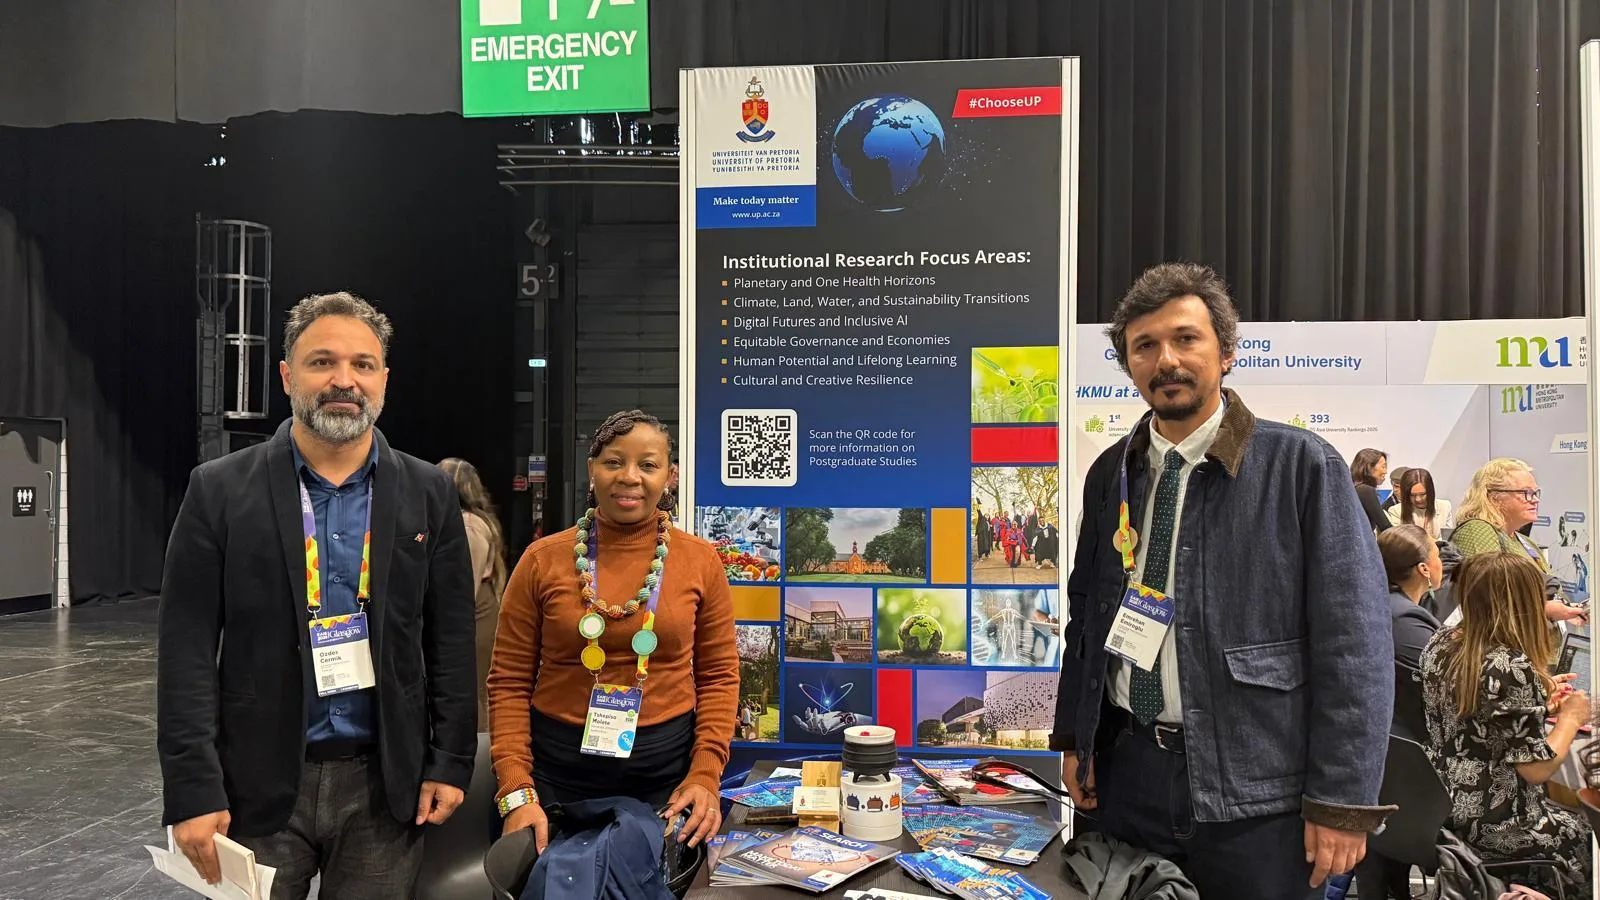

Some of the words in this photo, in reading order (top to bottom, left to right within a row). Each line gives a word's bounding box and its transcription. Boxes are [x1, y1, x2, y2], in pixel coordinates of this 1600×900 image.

[471, 30, 638, 62] EMERGENCY
[527, 64, 584, 92] EXIT
[968, 95, 1042, 109] #ChooseUP
[712, 150, 754, 158] UNIVERSITEIT
[712, 157, 753, 166] UNIVERSITY
[755, 157, 763, 165] OF
[713, 196, 739, 206] Make
[740, 195, 766, 207] today
[767, 196, 800, 204] matter
[731, 211, 780, 219] www.up.ac.za
[722, 253, 830, 270] Institutional
[835, 251, 915, 268] Research
[920, 250, 970, 267] Focus
[974, 249, 1032, 265] Areas:
[733, 276, 788, 292] Planetary
[790, 276, 812, 289] and
[815, 276, 840, 288] One
[842, 275, 881, 287] Health
[884, 274, 936, 286] Horizons
[733, 296, 780, 309] Climate,
[782, 295, 814, 309] Land,
[817, 295, 855, 308] Water,
[858, 294, 880, 307] and
[883, 293, 961, 308] Sustainability
[963, 291, 1030, 305] Transitions
[733, 315, 769, 331] Digital
[772, 315, 815, 328] Futures
[818, 315, 841, 328] and
[843, 314, 894, 327] Inclusive
[896, 314, 909, 326] AI
[733, 335, 787, 350] Equitable
[789, 335, 859, 348] Governance
[861, 334, 884, 347] and
[887, 333, 951, 346] Economies
[733, 354, 775, 367] Human
[778, 354, 829, 367] Potential
[831, 354, 854, 367] and
[857, 353, 903, 369] Lifelong
[906, 353, 958, 368] Learning
[1285, 355, 1362, 371] University
[733, 374, 779, 387] Cultural
[781, 373, 803, 386] and
[805, 373, 853, 386] Creative
[855, 372, 914, 386] Resilience
[1115, 386, 1130, 398] at
[1310, 414, 1330, 423] 393
[809, 429, 833, 439] Scan
[835, 429, 853, 439] the
[855, 429, 871, 440] QR
[873, 429, 898, 439] code
[900, 429, 916, 439] for
[809, 444, 837, 453] more
[839, 443, 899, 453] information
[901, 444, 915, 453] on
[809, 456, 877, 469] Postgraduate
[879, 456, 918, 466] Studies
